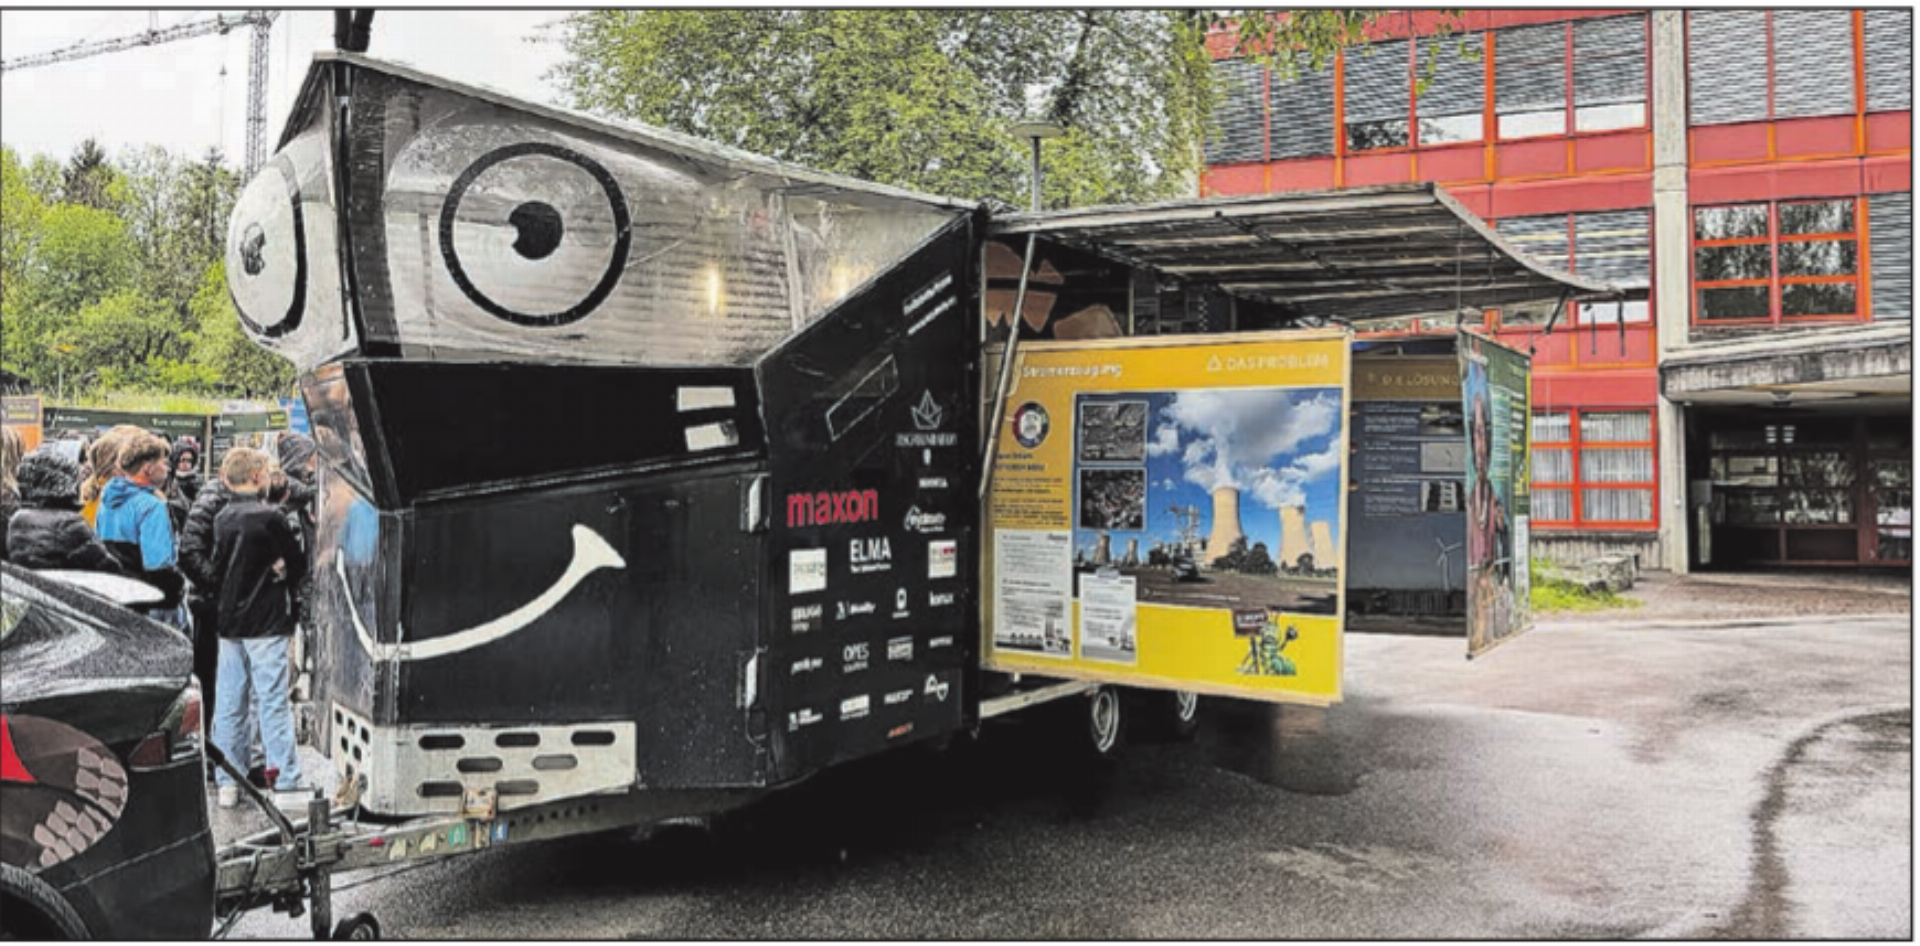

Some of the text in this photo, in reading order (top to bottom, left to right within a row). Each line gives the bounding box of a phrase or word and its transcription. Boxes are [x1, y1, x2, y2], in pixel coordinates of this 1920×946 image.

[1257, 353, 1328, 370] PROBLEM
[787, 489, 878, 527] maxon
[850, 536, 891, 563] ELMA
